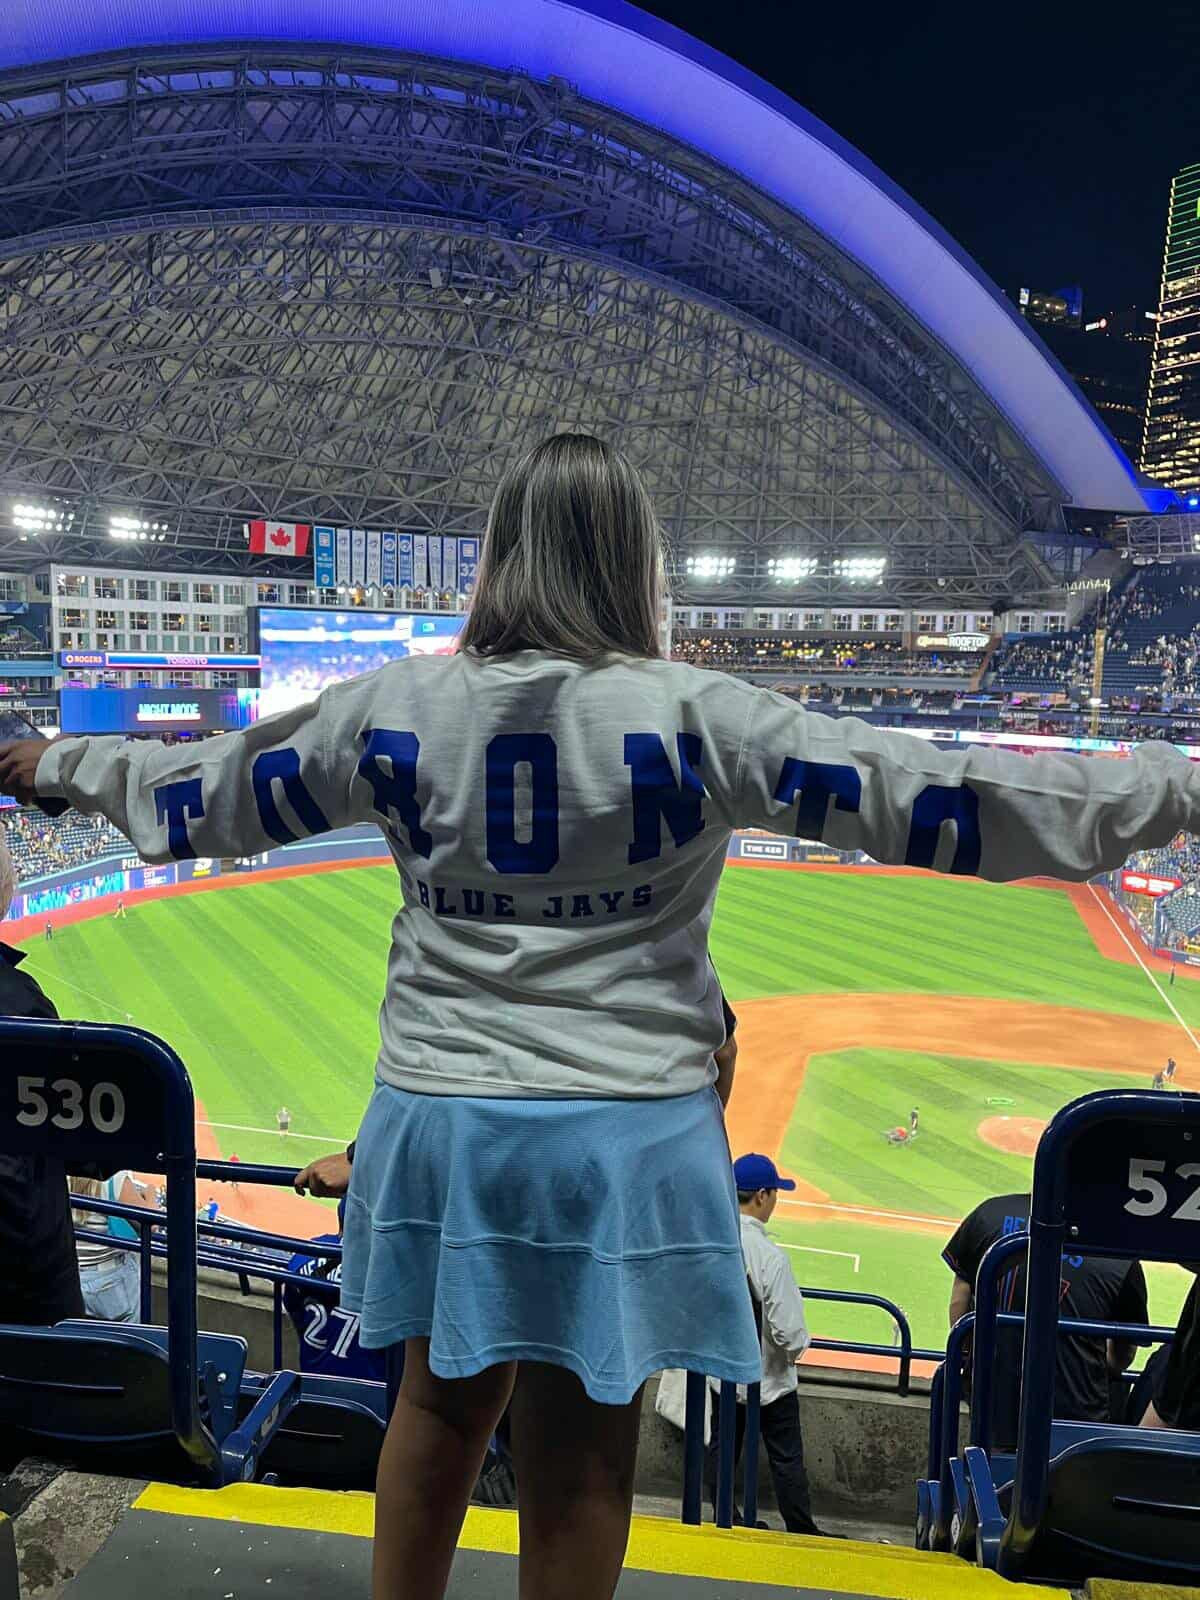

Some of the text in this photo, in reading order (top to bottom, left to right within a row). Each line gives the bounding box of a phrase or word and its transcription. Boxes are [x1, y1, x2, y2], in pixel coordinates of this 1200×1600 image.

[460, 562, 477, 577] 32
[73, 655, 103, 664] ROGERS
[165, 655, 208, 665] TORONTO
[138, 702, 200, 715] NIGHT MODE
[416, 879, 653, 919] BLUE JAYS
[16, 1076, 126, 1134] 530
[1123, 1157, 1200, 1221] 52
[303, 1302, 360, 1359] 27
